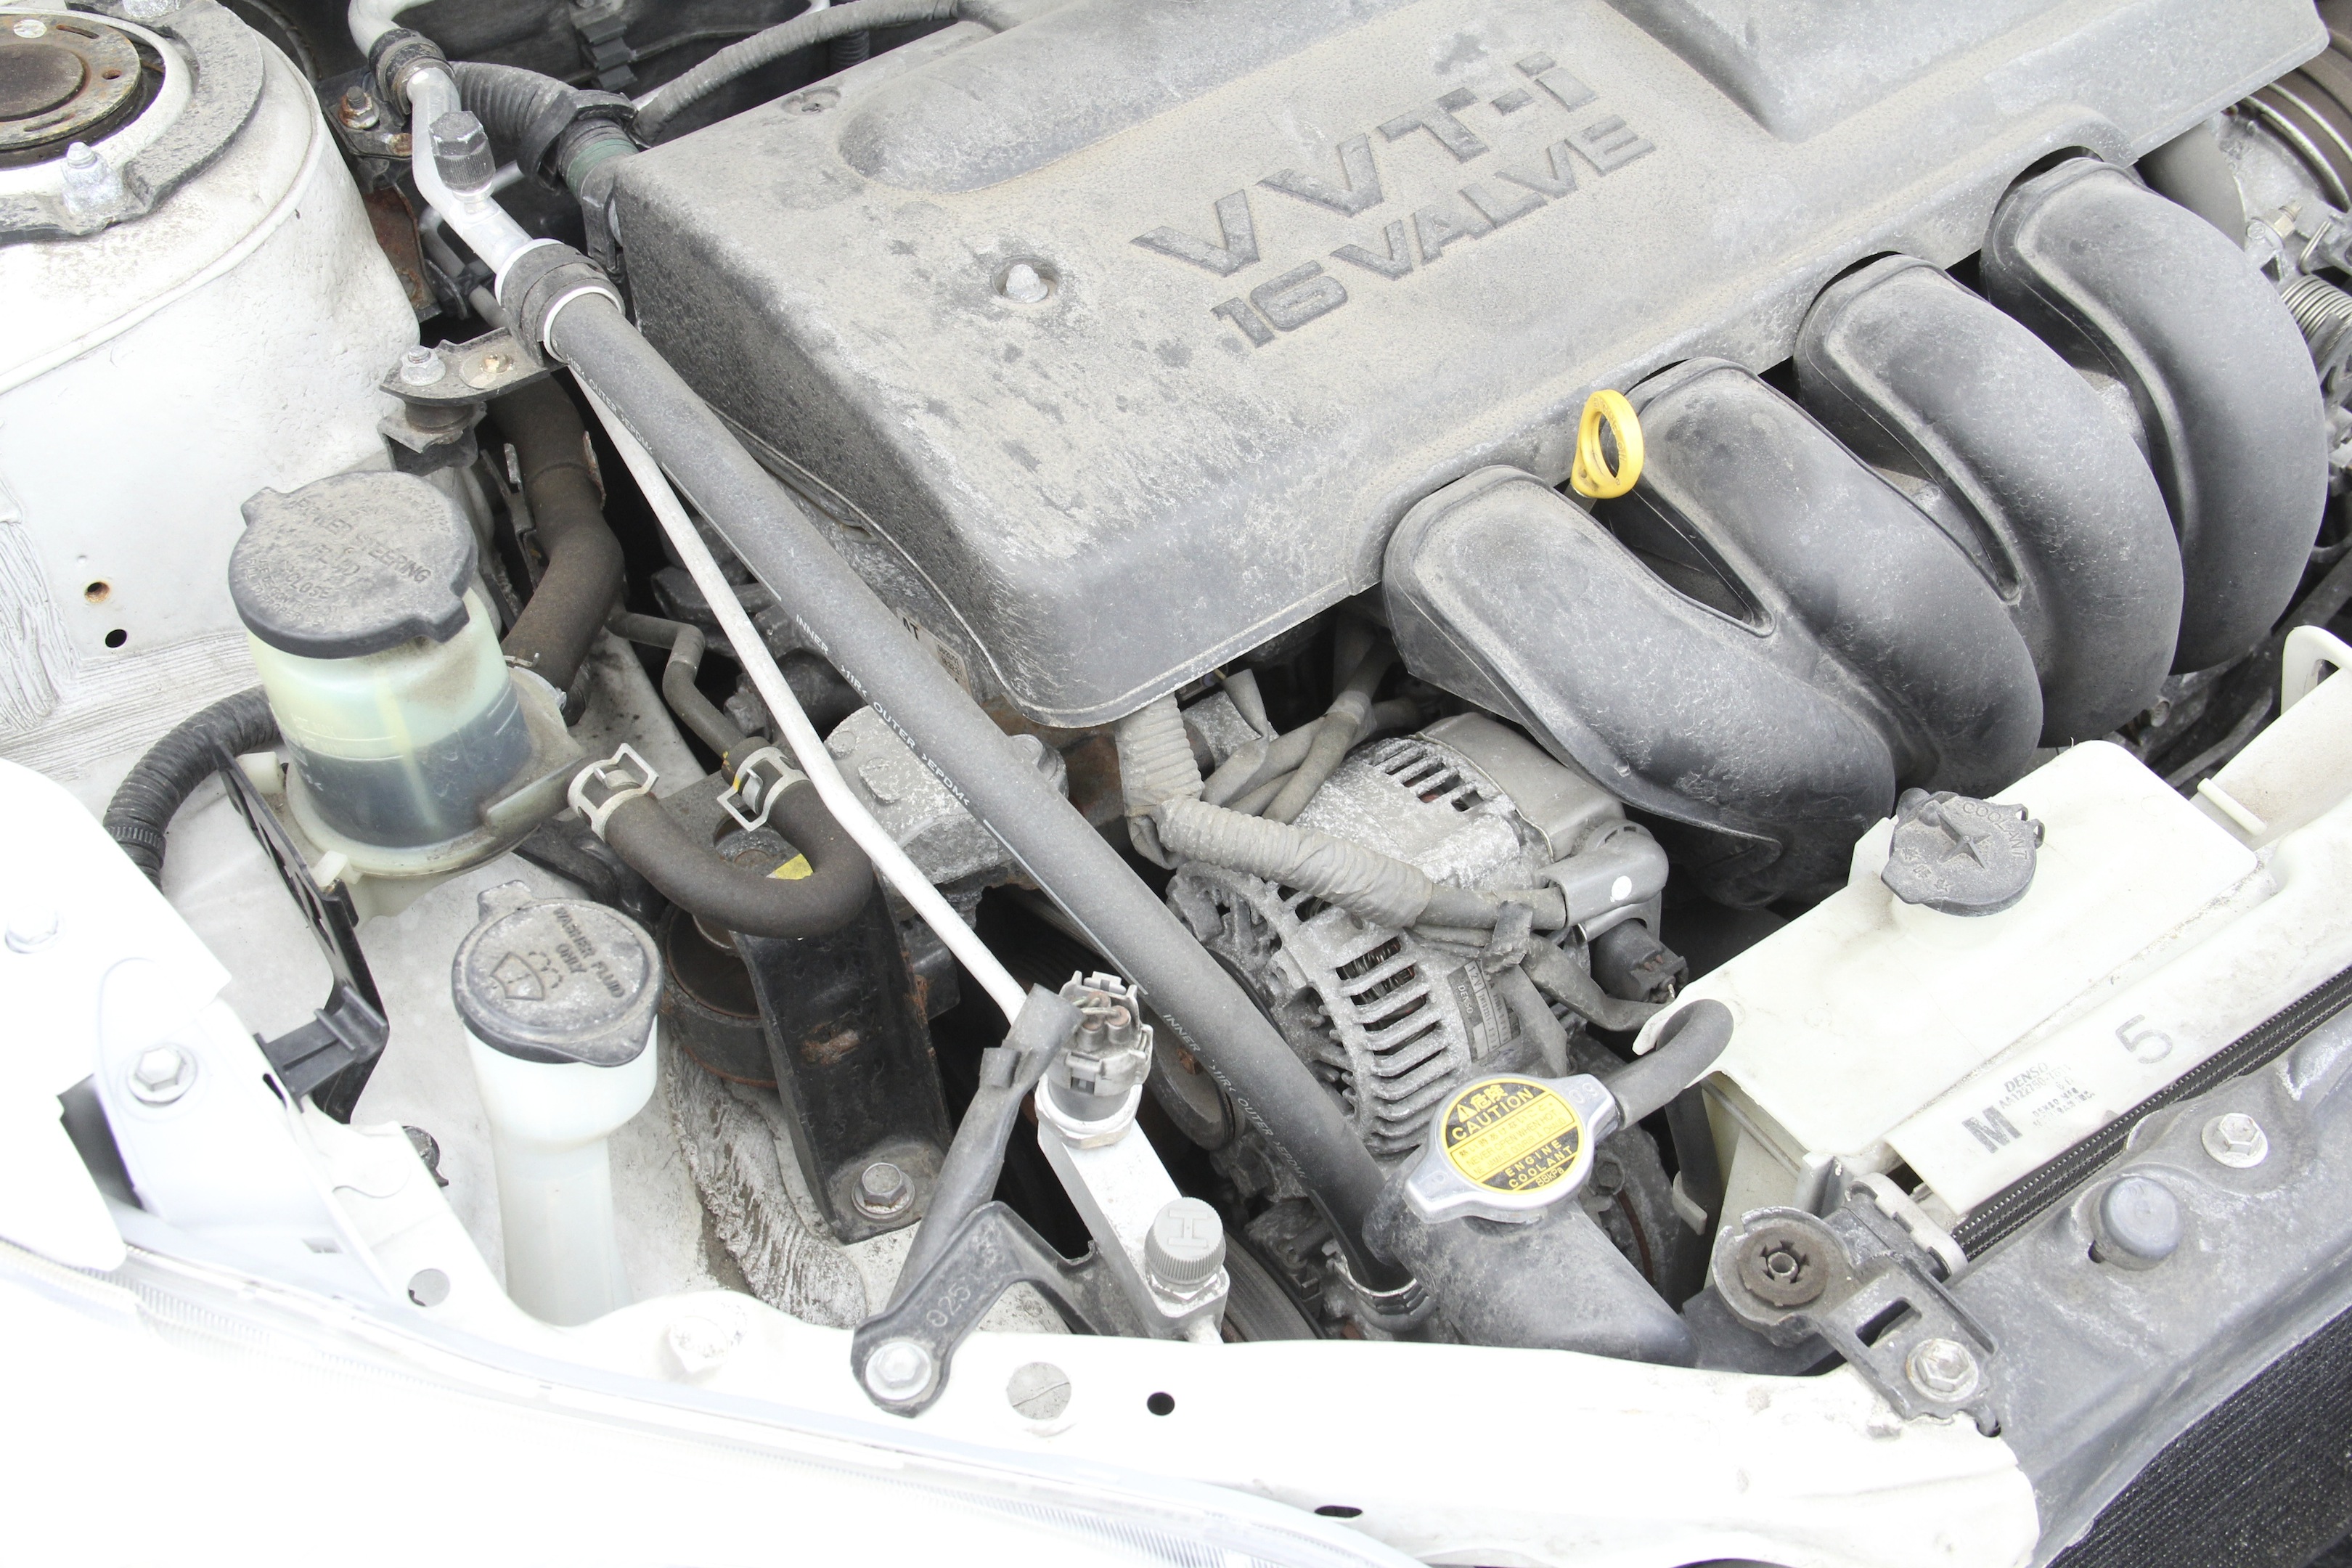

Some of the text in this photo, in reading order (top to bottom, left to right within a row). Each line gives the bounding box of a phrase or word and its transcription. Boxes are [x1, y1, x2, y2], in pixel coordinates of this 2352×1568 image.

[1130, 51, 1598, 278] VVT-i
[1210, 114, 1656, 348] 16 VALVE
[589, 378, 617, 413] OUTER
[356, 532, 432, 584] STEERING
[285, 573, 332, 599] CLOSE
[796, 614, 829, 655] INNER
[873, 701, 917, 750] OUTER
[920, 752, 971, 807] >EPDM<
[1962, 801, 2030, 860] COOLANT
[552, 907, 625, 999] WASHER FLUID
[555, 943, 588, 974] ONLY
[1468, 965, 1482, 987] 12V
[1457, 984, 1474, 1015] DENSO
[2114, 1013, 2173, 1065] 5
[1162, 1013, 1202, 1053] INNER
[1237, 1096, 1275, 1137] OUTER
[1470, 1084, 1508, 1113] 危険
[2004, 1061, 2049, 1093] DENSO
[1451, 1087, 1535, 1141] CAUTION
[1466, 1109, 1558, 1166] NEVER OPEN WHEN HOT
[1961, 1105, 2023, 1154] M
[1473, 1166, 1484, 1175] NE
[1486, 1151, 1511, 1168] JAMAIS
[1510, 1136, 1535, 1153] OUVRIR
[1543, 1117, 1567, 1134] CHAUD
[1504, 1139, 1562, 1177] ENGINE
[1508, 1145, 1574, 1189] COOLANT
[1535, 1167, 1565, 1187] 88kPa
